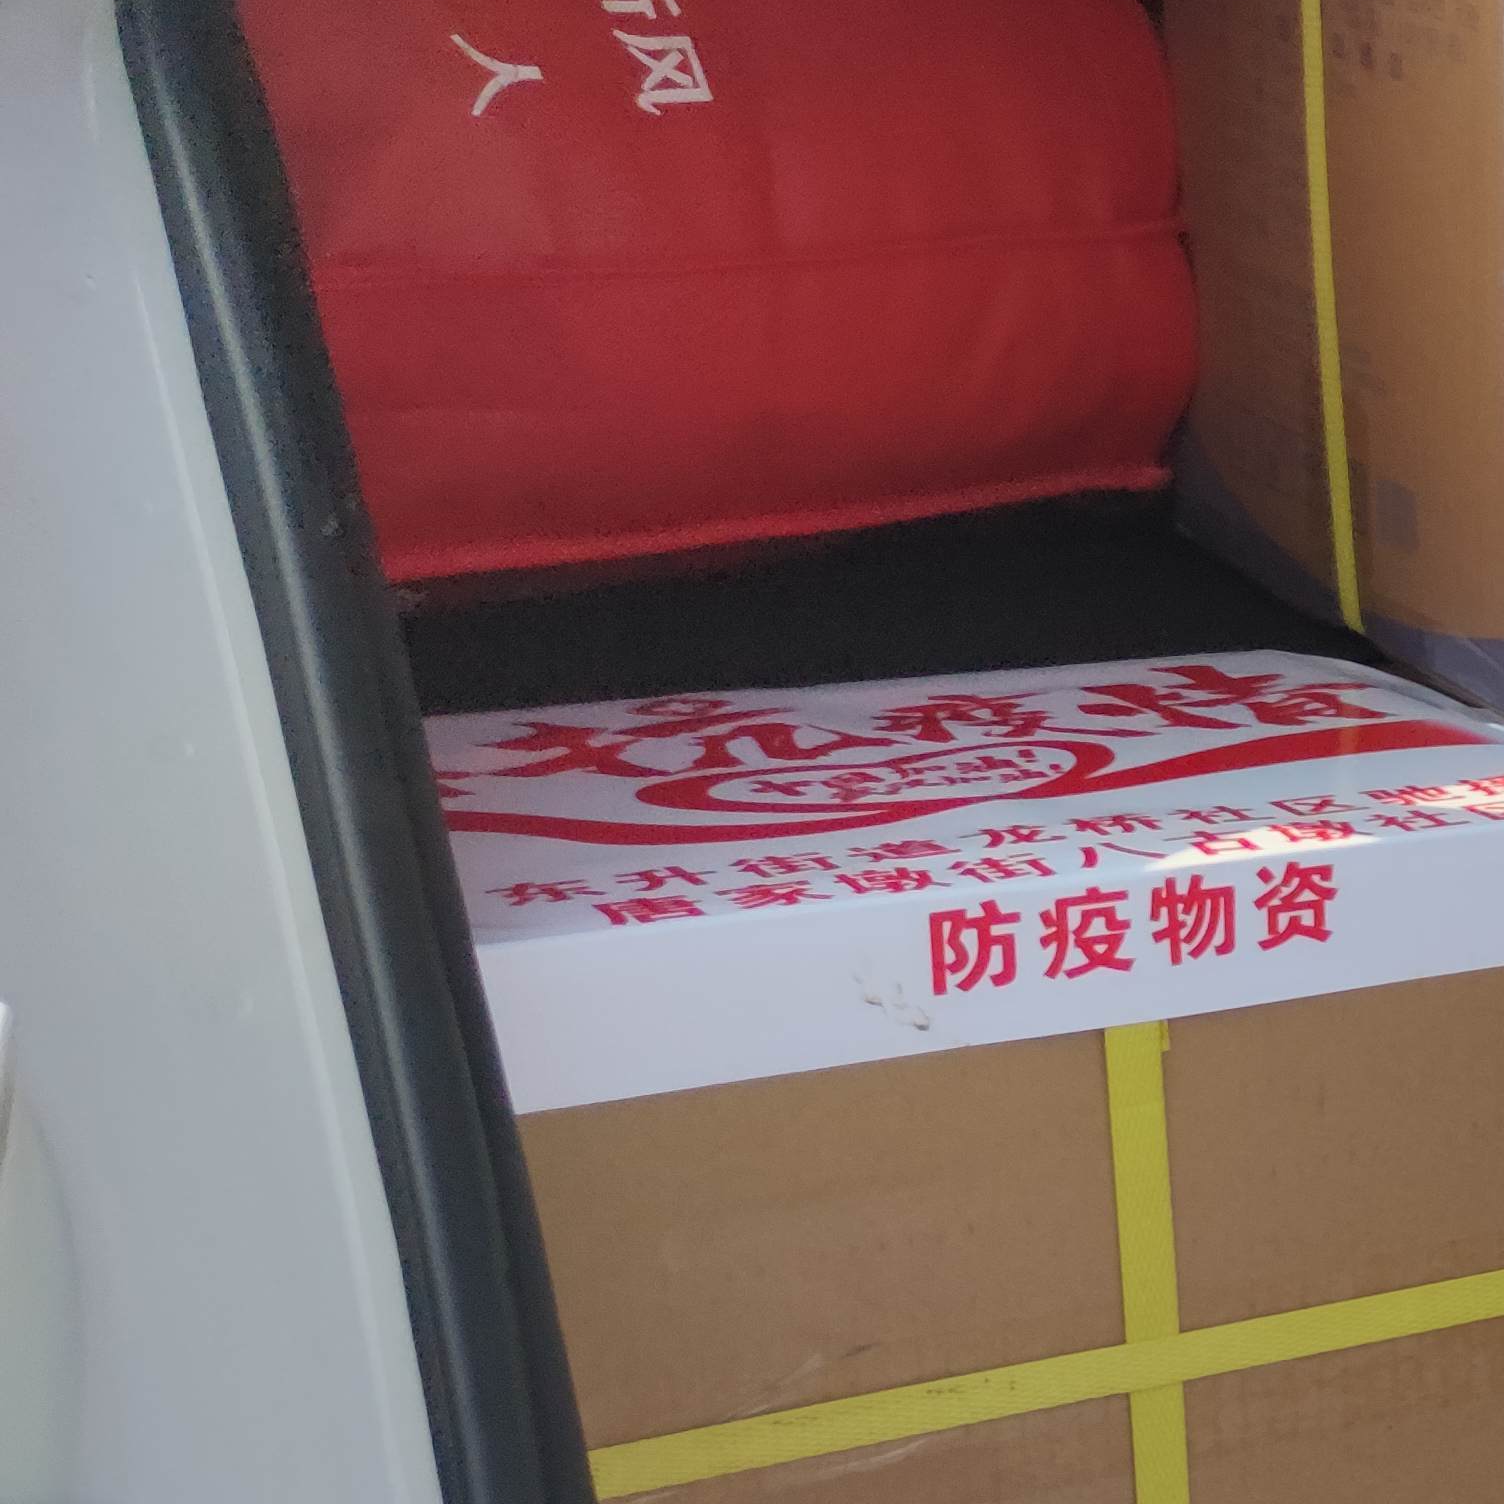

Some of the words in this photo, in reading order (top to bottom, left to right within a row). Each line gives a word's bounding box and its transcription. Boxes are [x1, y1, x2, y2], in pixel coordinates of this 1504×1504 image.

[438, 665, 1393, 796] 抗疫情
[929, 861, 1337, 996] 防疫物资
